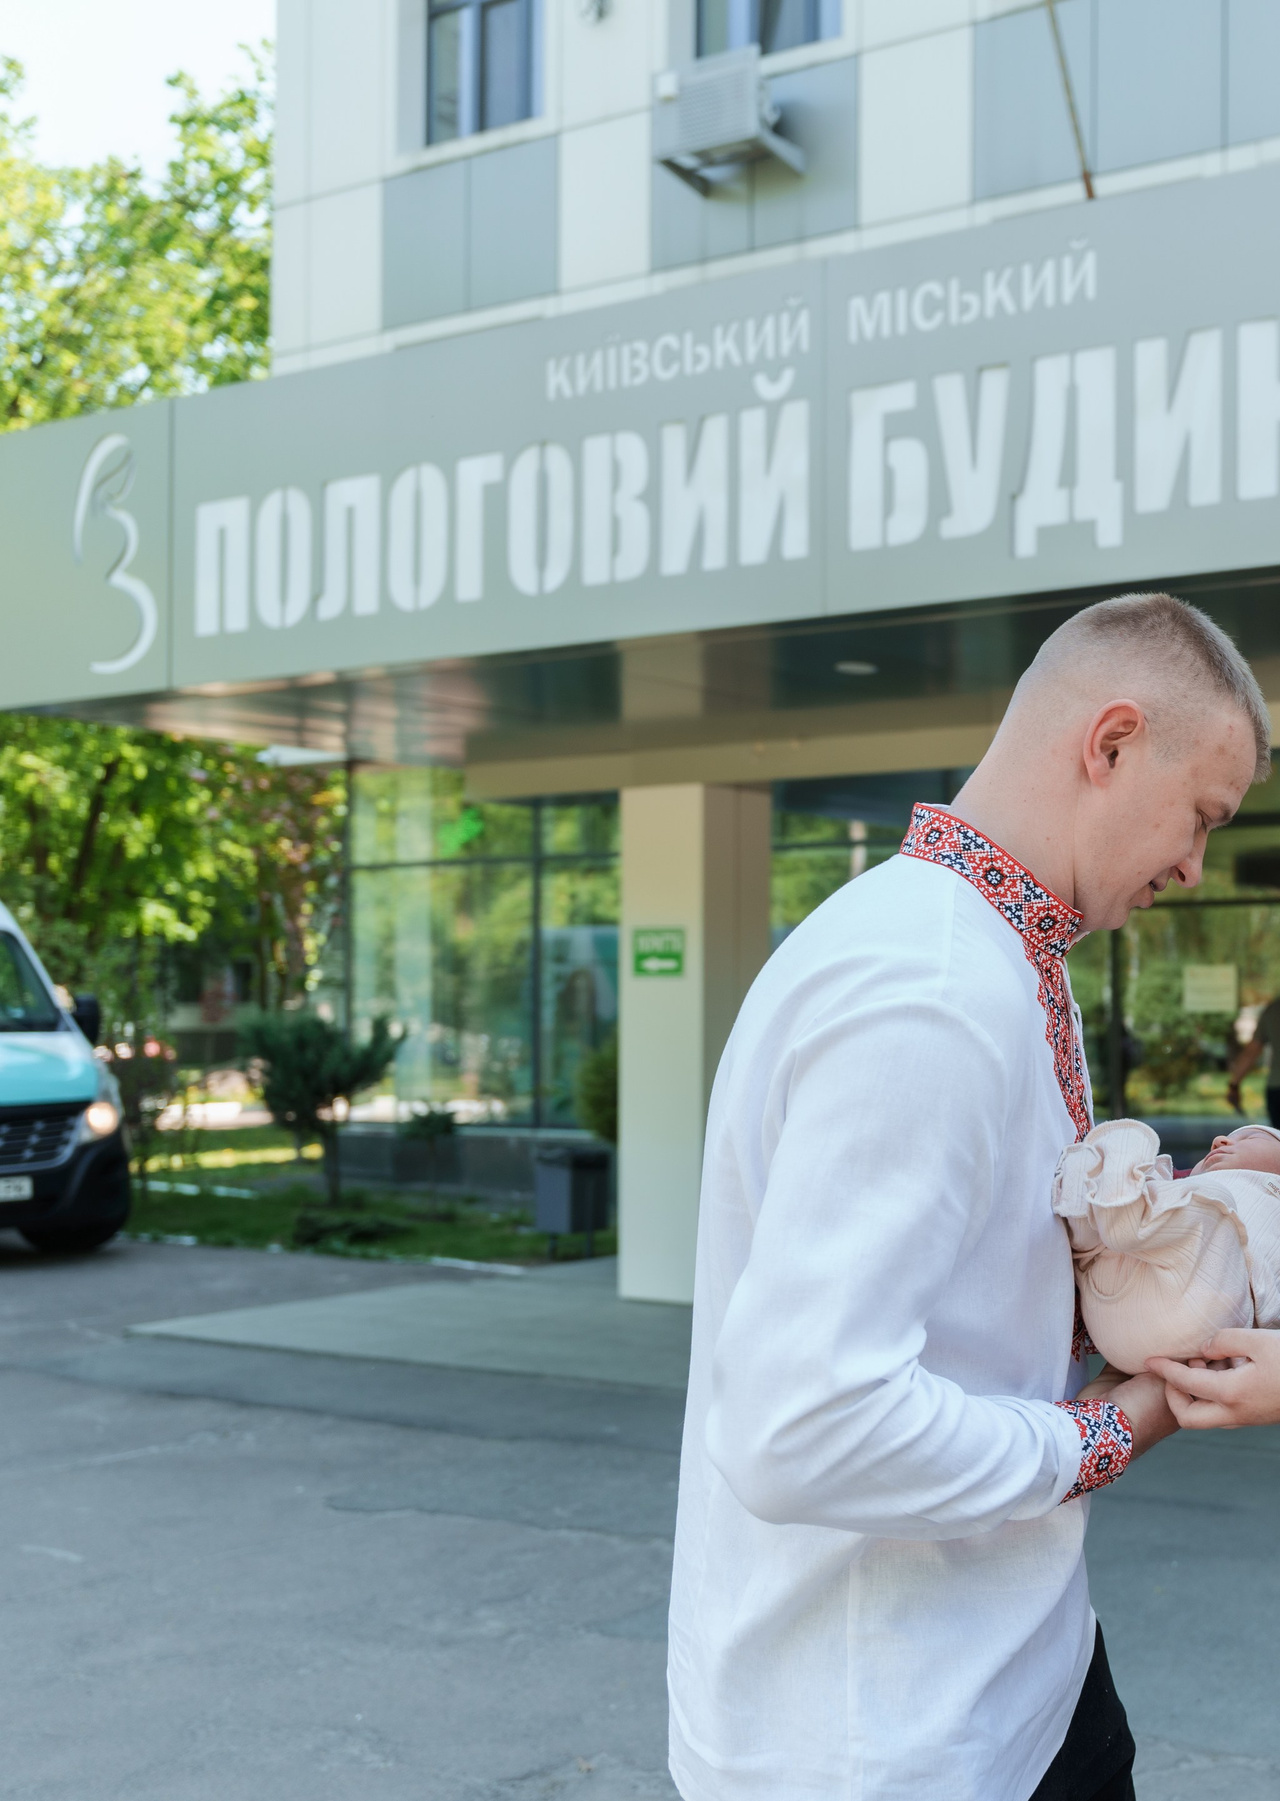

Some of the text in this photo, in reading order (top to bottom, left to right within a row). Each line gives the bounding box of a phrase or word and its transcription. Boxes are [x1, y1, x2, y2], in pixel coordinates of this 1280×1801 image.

[546, 239, 1098, 401] КИЇВСЬКИЙ МІСЬКИЙ
[194, 366, 811, 638] ПОЛОГОВИЙ
